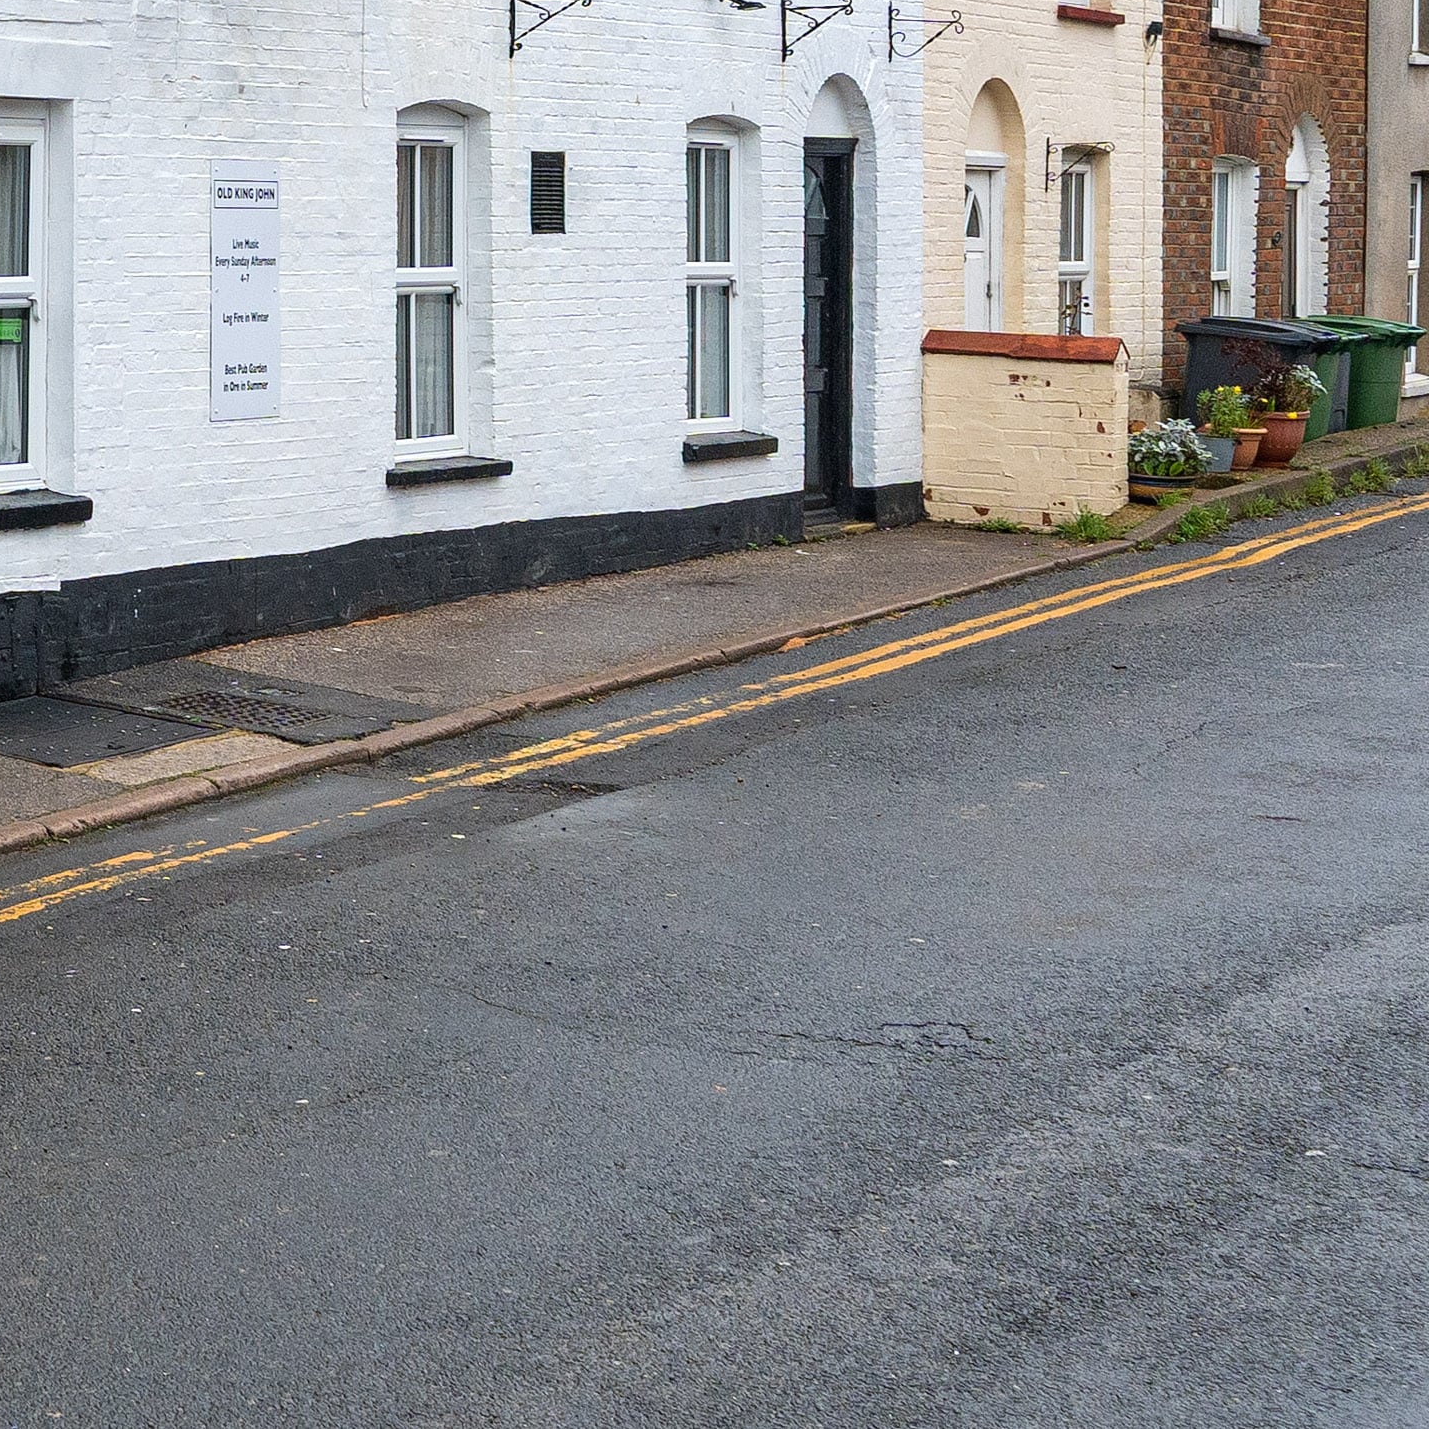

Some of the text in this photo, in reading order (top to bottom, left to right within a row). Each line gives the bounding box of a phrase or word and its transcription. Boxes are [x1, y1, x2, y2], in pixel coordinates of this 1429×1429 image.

[217, 187, 275, 202] OLD KING JOHN
[232, 238, 260, 250] Live Music
[215, 256, 277, 270] Every Sunday Afternoon
[222, 313, 233, 326] Log
[244, 312, 250, 323] in
[250, 312, 269, 322] Winter
[237, 364, 248, 374] Pub
[248, 363, 268, 374] Garden
[246, 379, 269, 391] Summer
